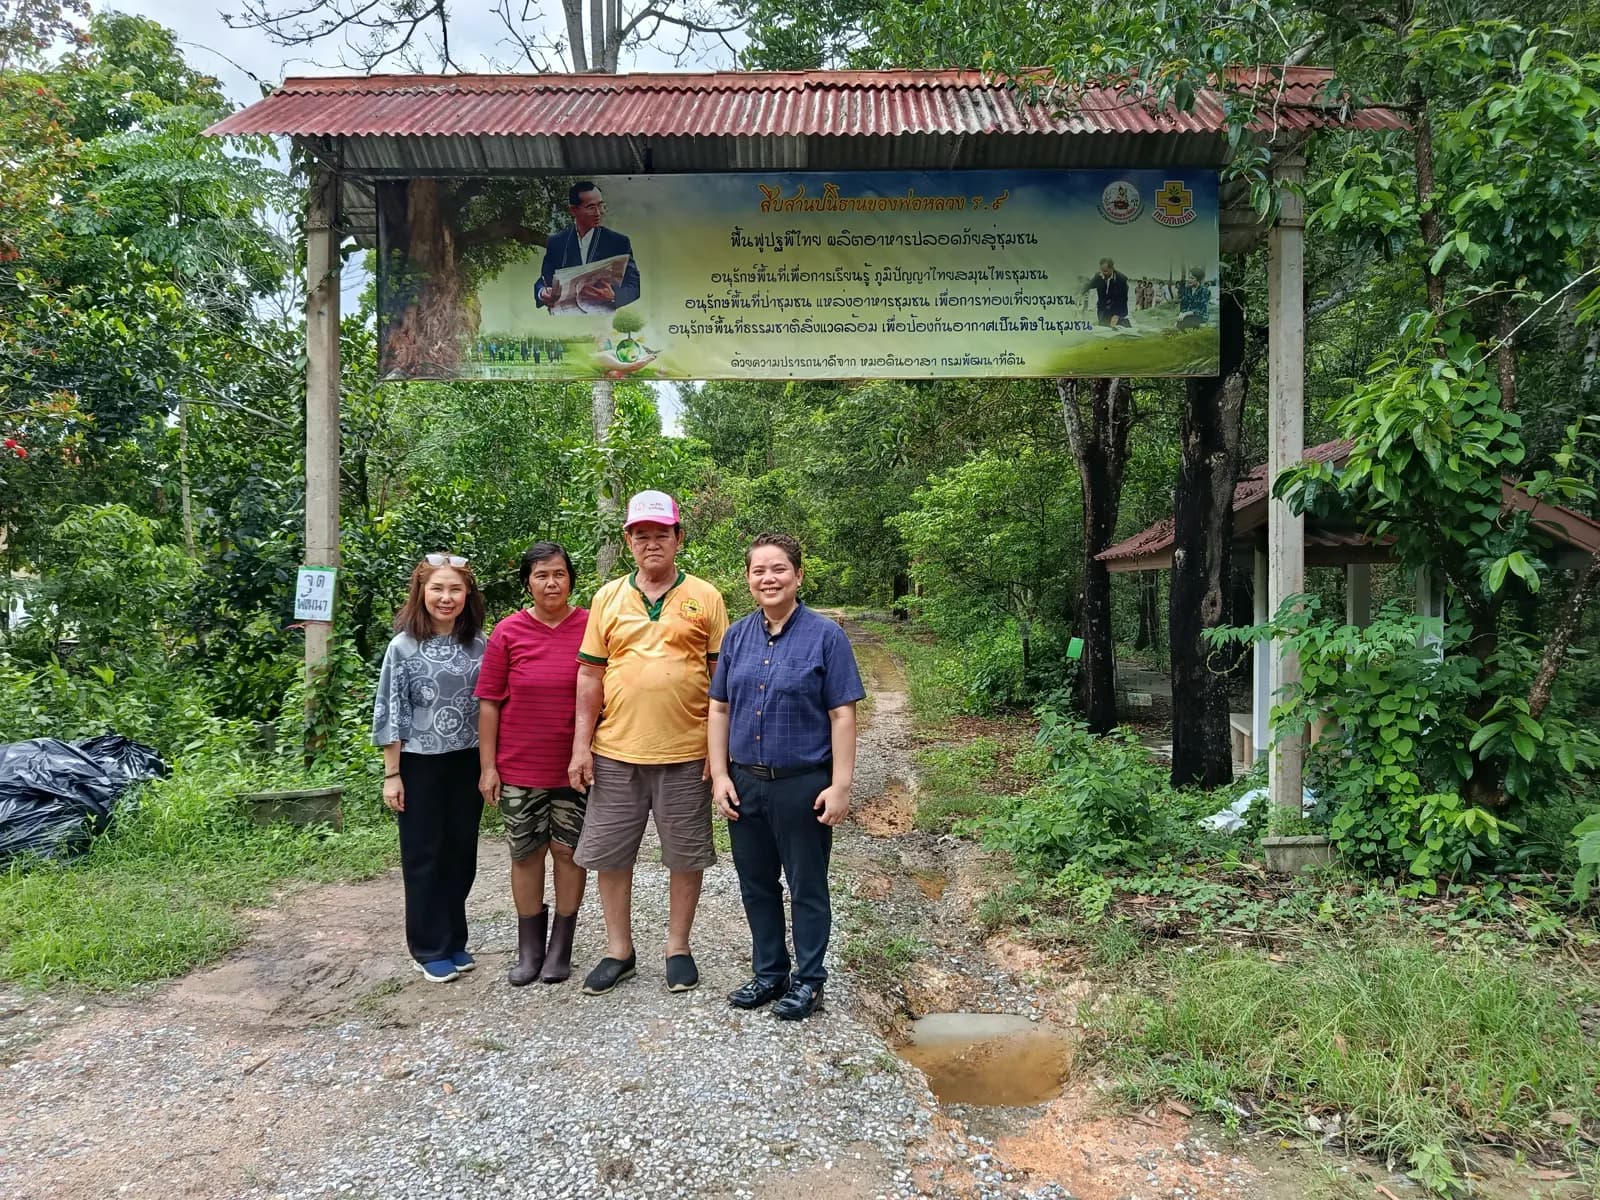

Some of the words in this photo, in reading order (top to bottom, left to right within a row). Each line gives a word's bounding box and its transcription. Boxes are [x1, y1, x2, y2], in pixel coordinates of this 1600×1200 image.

[731, 226, 821, 252] ฟื้นฟูปฐพีไทย
[827, 224, 1038, 250] ผลิตอาหารปลอดภัยสู่ชุมชน
[711, 262, 872, 287] อนุรักษ์พื้นที่เพื่อการเรียนรู้
[875, 266, 1048, 286] ภูมิปัญญาไทยสมุนไพรชุมชน
[685, 290, 811, 313] อนุรักษ์พื้นที่ป่าชุมชน
[816, 289, 930, 311] แหล่งอาหารชุมชน
[935, 289, 1075, 311] เพื่อการท่องเที่ยวชุมชน
[668, 314, 877, 337] อนุรักษ์พื้นที่ธรรมชาติสิ่งแวดล้อม
[882, 314, 1093, 335] เพื่อป้องกันอากาศเป็นพิษในชุมชน
[730, 352, 856, 368] ด้วยความปรารถนาดีจาก
[860, 353, 936, 366] หมอดินอาสา
[941, 350, 1026, 366] กรมพัฒนาที่ดิน
